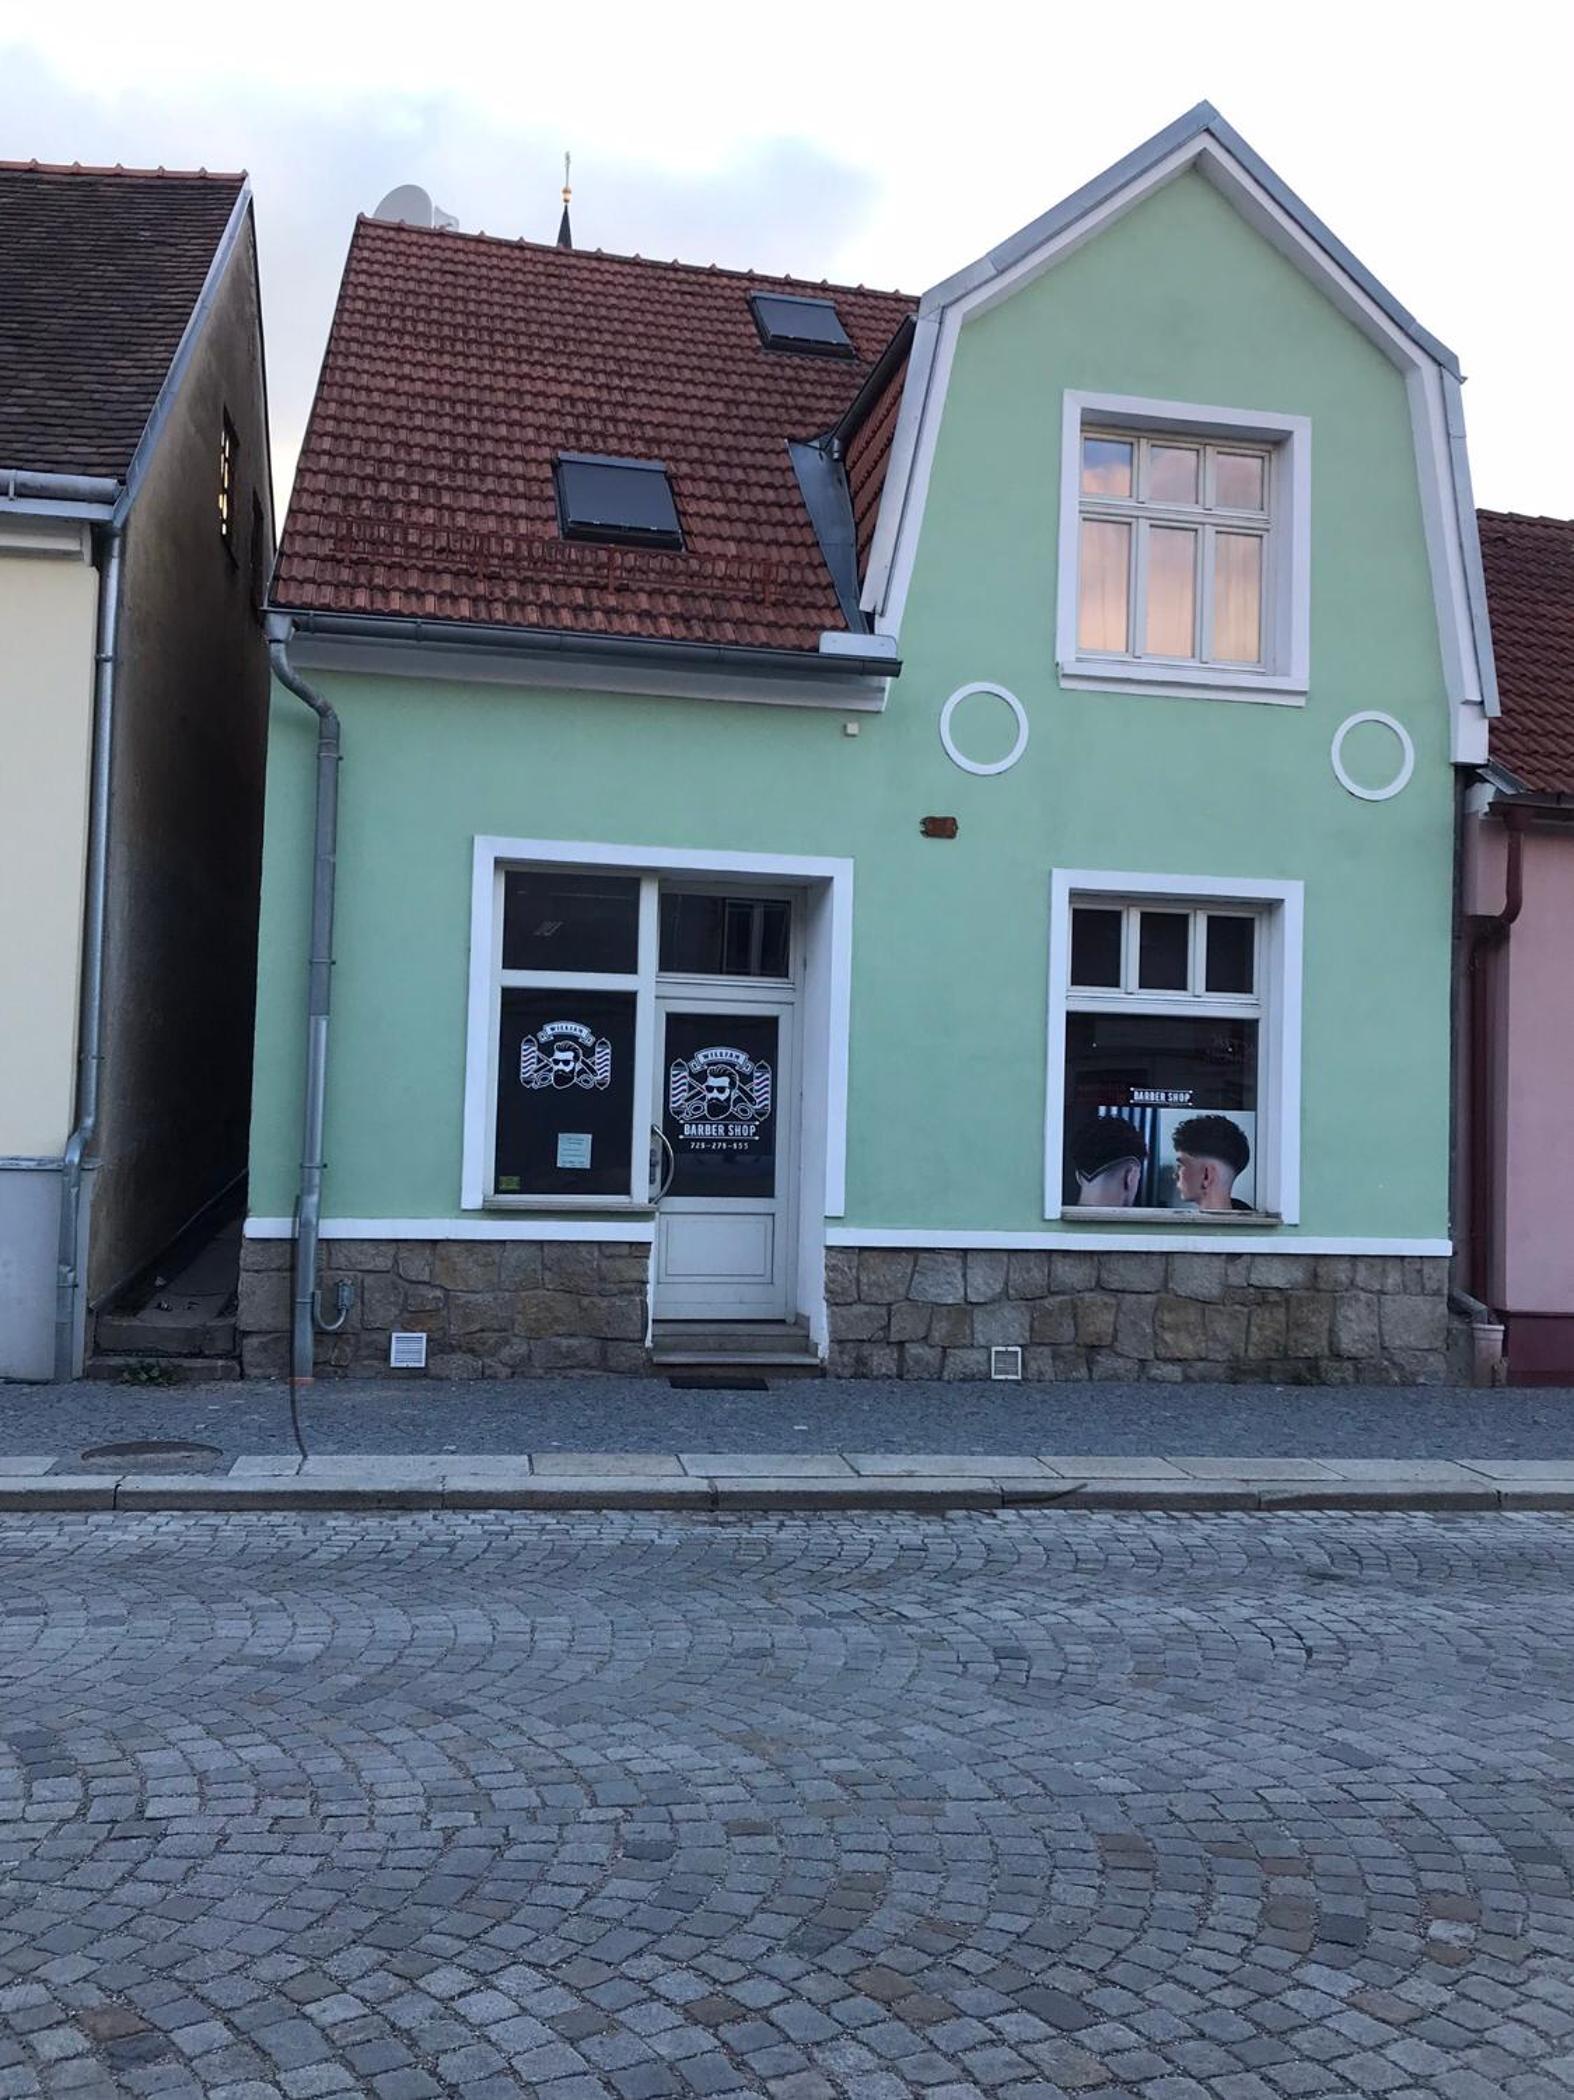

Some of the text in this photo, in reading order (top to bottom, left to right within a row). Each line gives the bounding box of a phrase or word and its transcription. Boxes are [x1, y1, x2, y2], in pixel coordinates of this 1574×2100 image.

[1133, 1090, 1191, 1103] BARBER SHOP
[684, 1123, 756, 1137] BARBER SHOP
